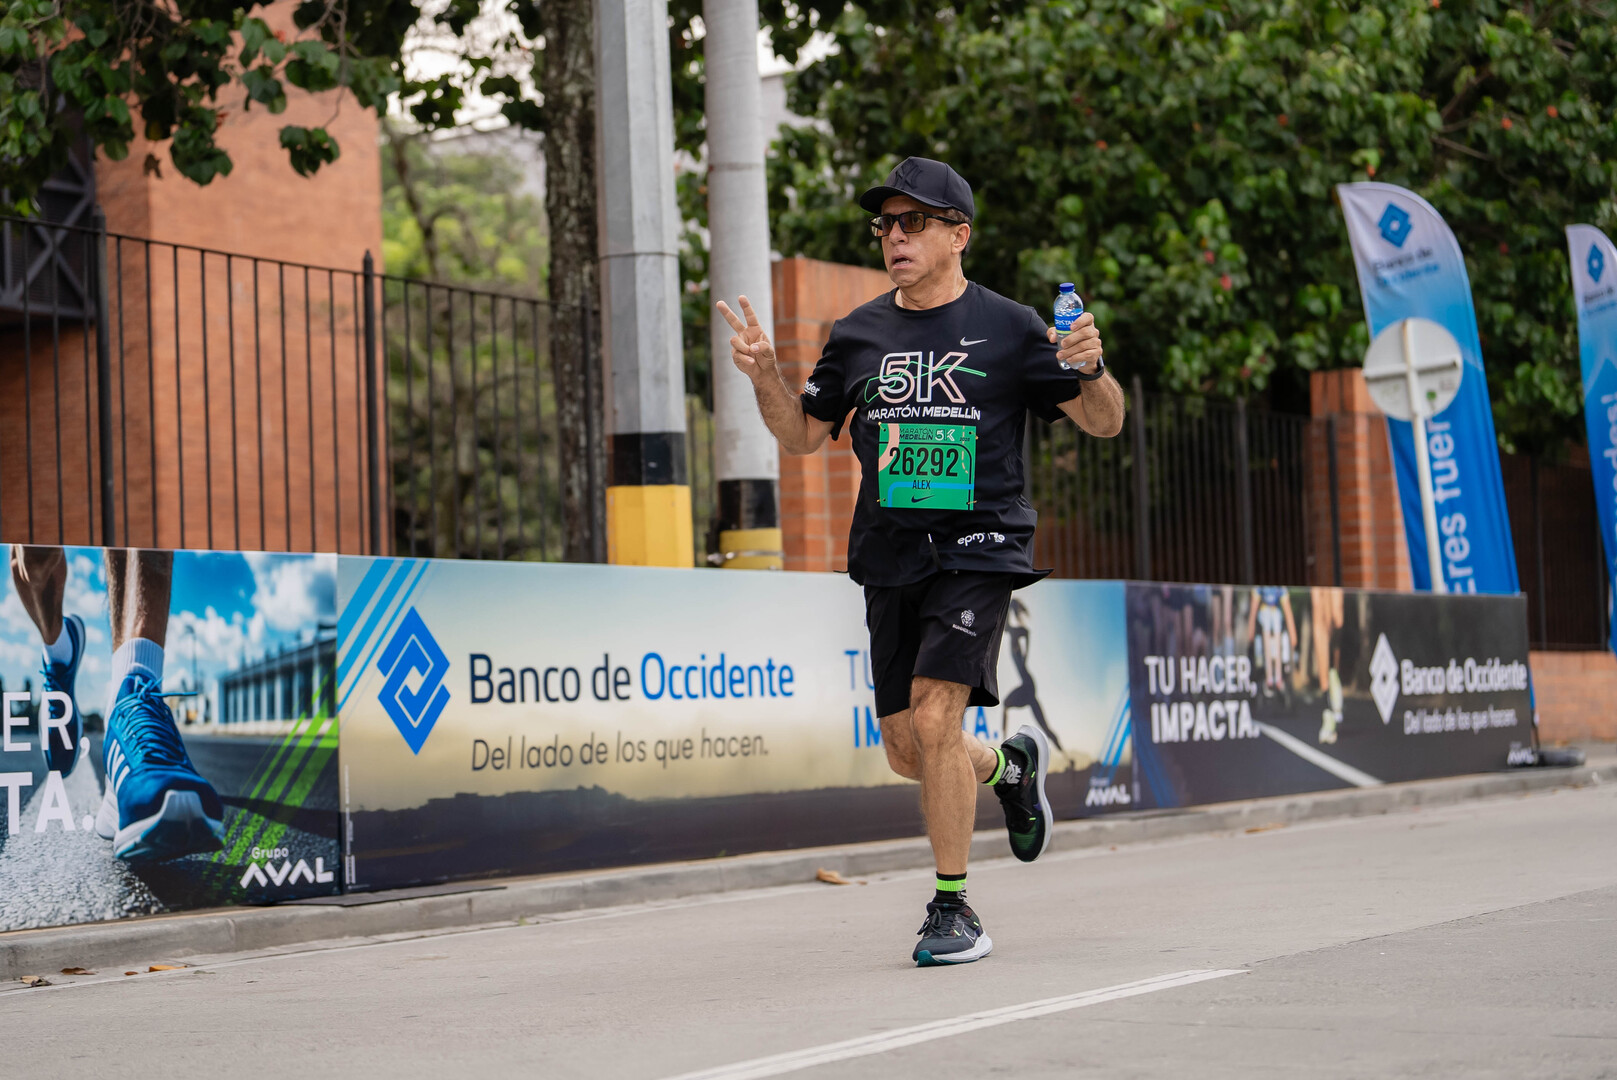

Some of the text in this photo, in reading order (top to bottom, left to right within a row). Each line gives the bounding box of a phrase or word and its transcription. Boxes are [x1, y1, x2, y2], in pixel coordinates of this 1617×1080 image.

[878, 351, 969, 404] 5K
[867, 404, 981, 421] MARATÓN MEDELLÍN
[899, 427, 955, 441] MARATÓN 5K
[899, 433, 933, 441] MEDELLÍN
[889, 446, 959, 477] 26292
[912, 480, 931, 490] ALEX
[957, 532, 985, 547] epm
[469, 652, 795, 704] Banco de Occidente
[1143, 655, 1258, 698] TU HACER,
[1400, 656, 1528, 696] Banco de Occidente
[1151, 699, 1261, 744] IMPACTA.
[471, 727, 769, 772] Del lado de los que hacen.
[1085, 783, 1131, 807] AVAL
[251, 846, 290, 860] Grupo
[239, 856, 334, 889] AVAL
